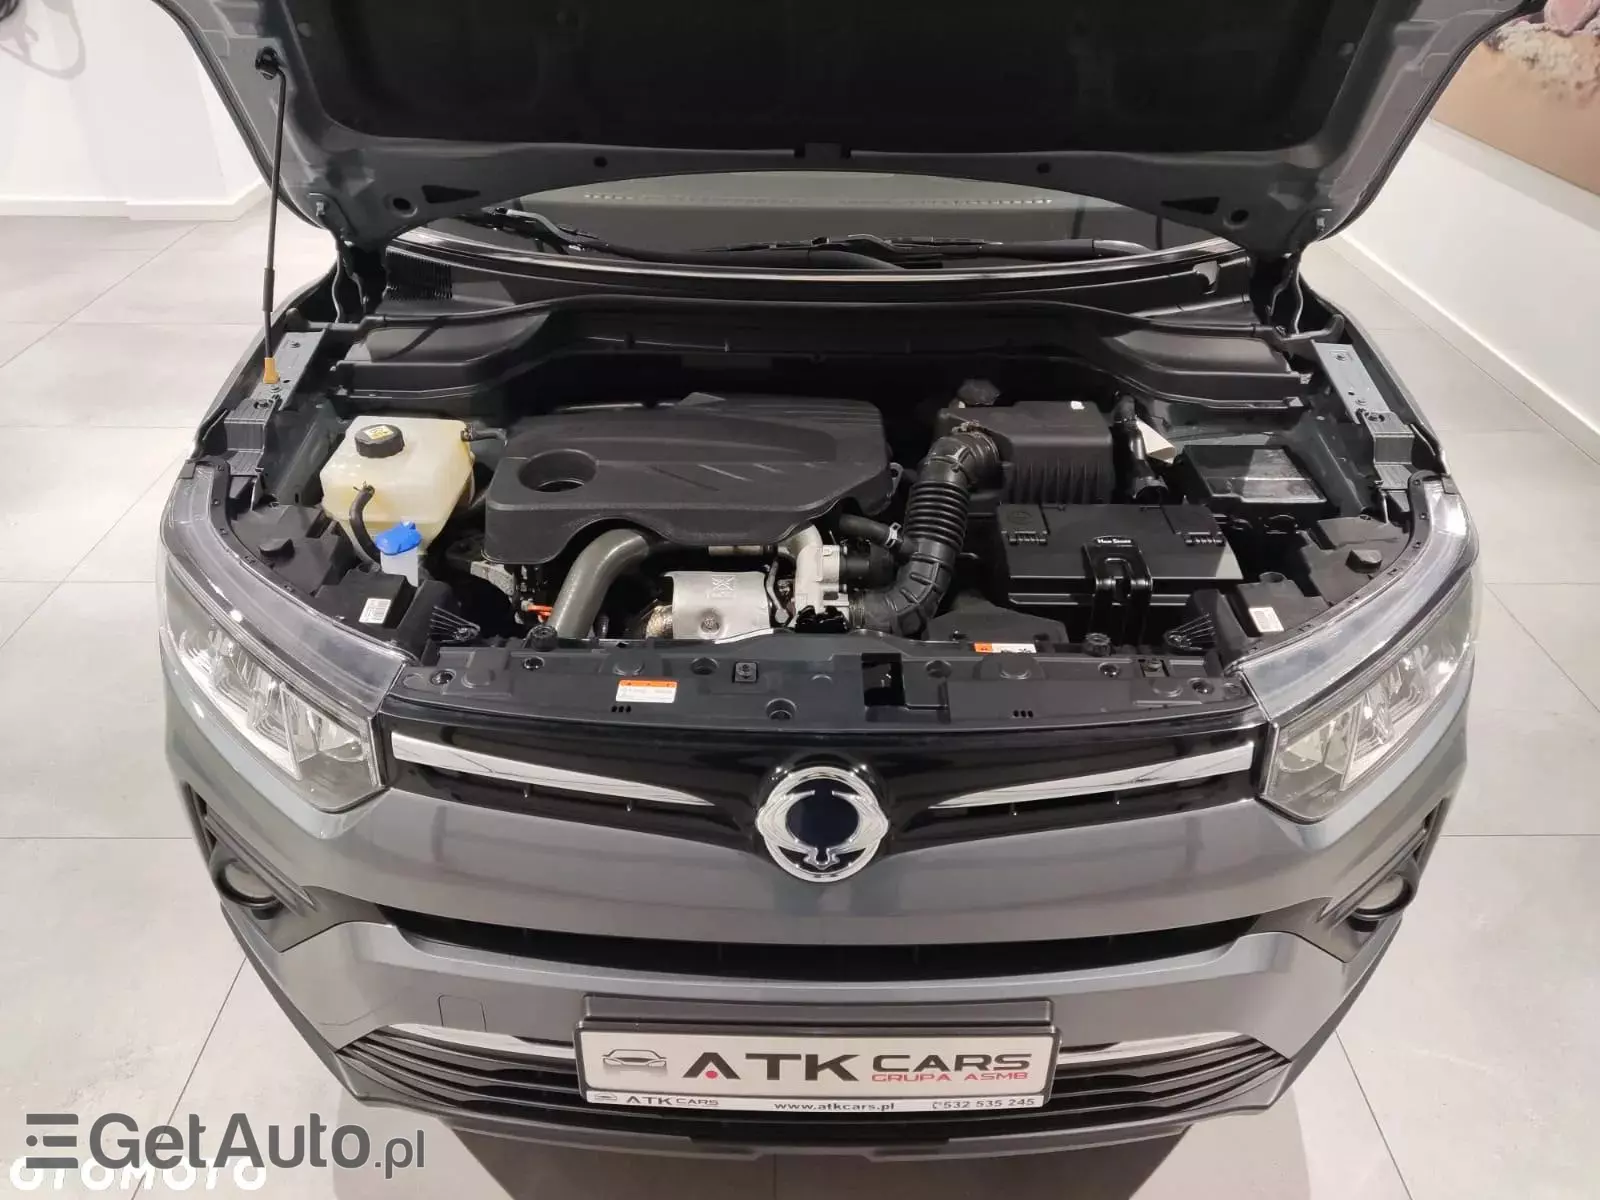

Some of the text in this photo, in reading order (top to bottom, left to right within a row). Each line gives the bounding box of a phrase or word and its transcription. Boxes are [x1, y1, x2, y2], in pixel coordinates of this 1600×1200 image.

[683, 1052, 1033, 1082] ATK CARS
[871, 1072, 952, 1083] GRUPA
[626, 1095, 719, 1106] ATK CARS
[943, 1098, 1036, 1109] 532 535 245
[773, 1102, 895, 1112] www.atkcars.pl
